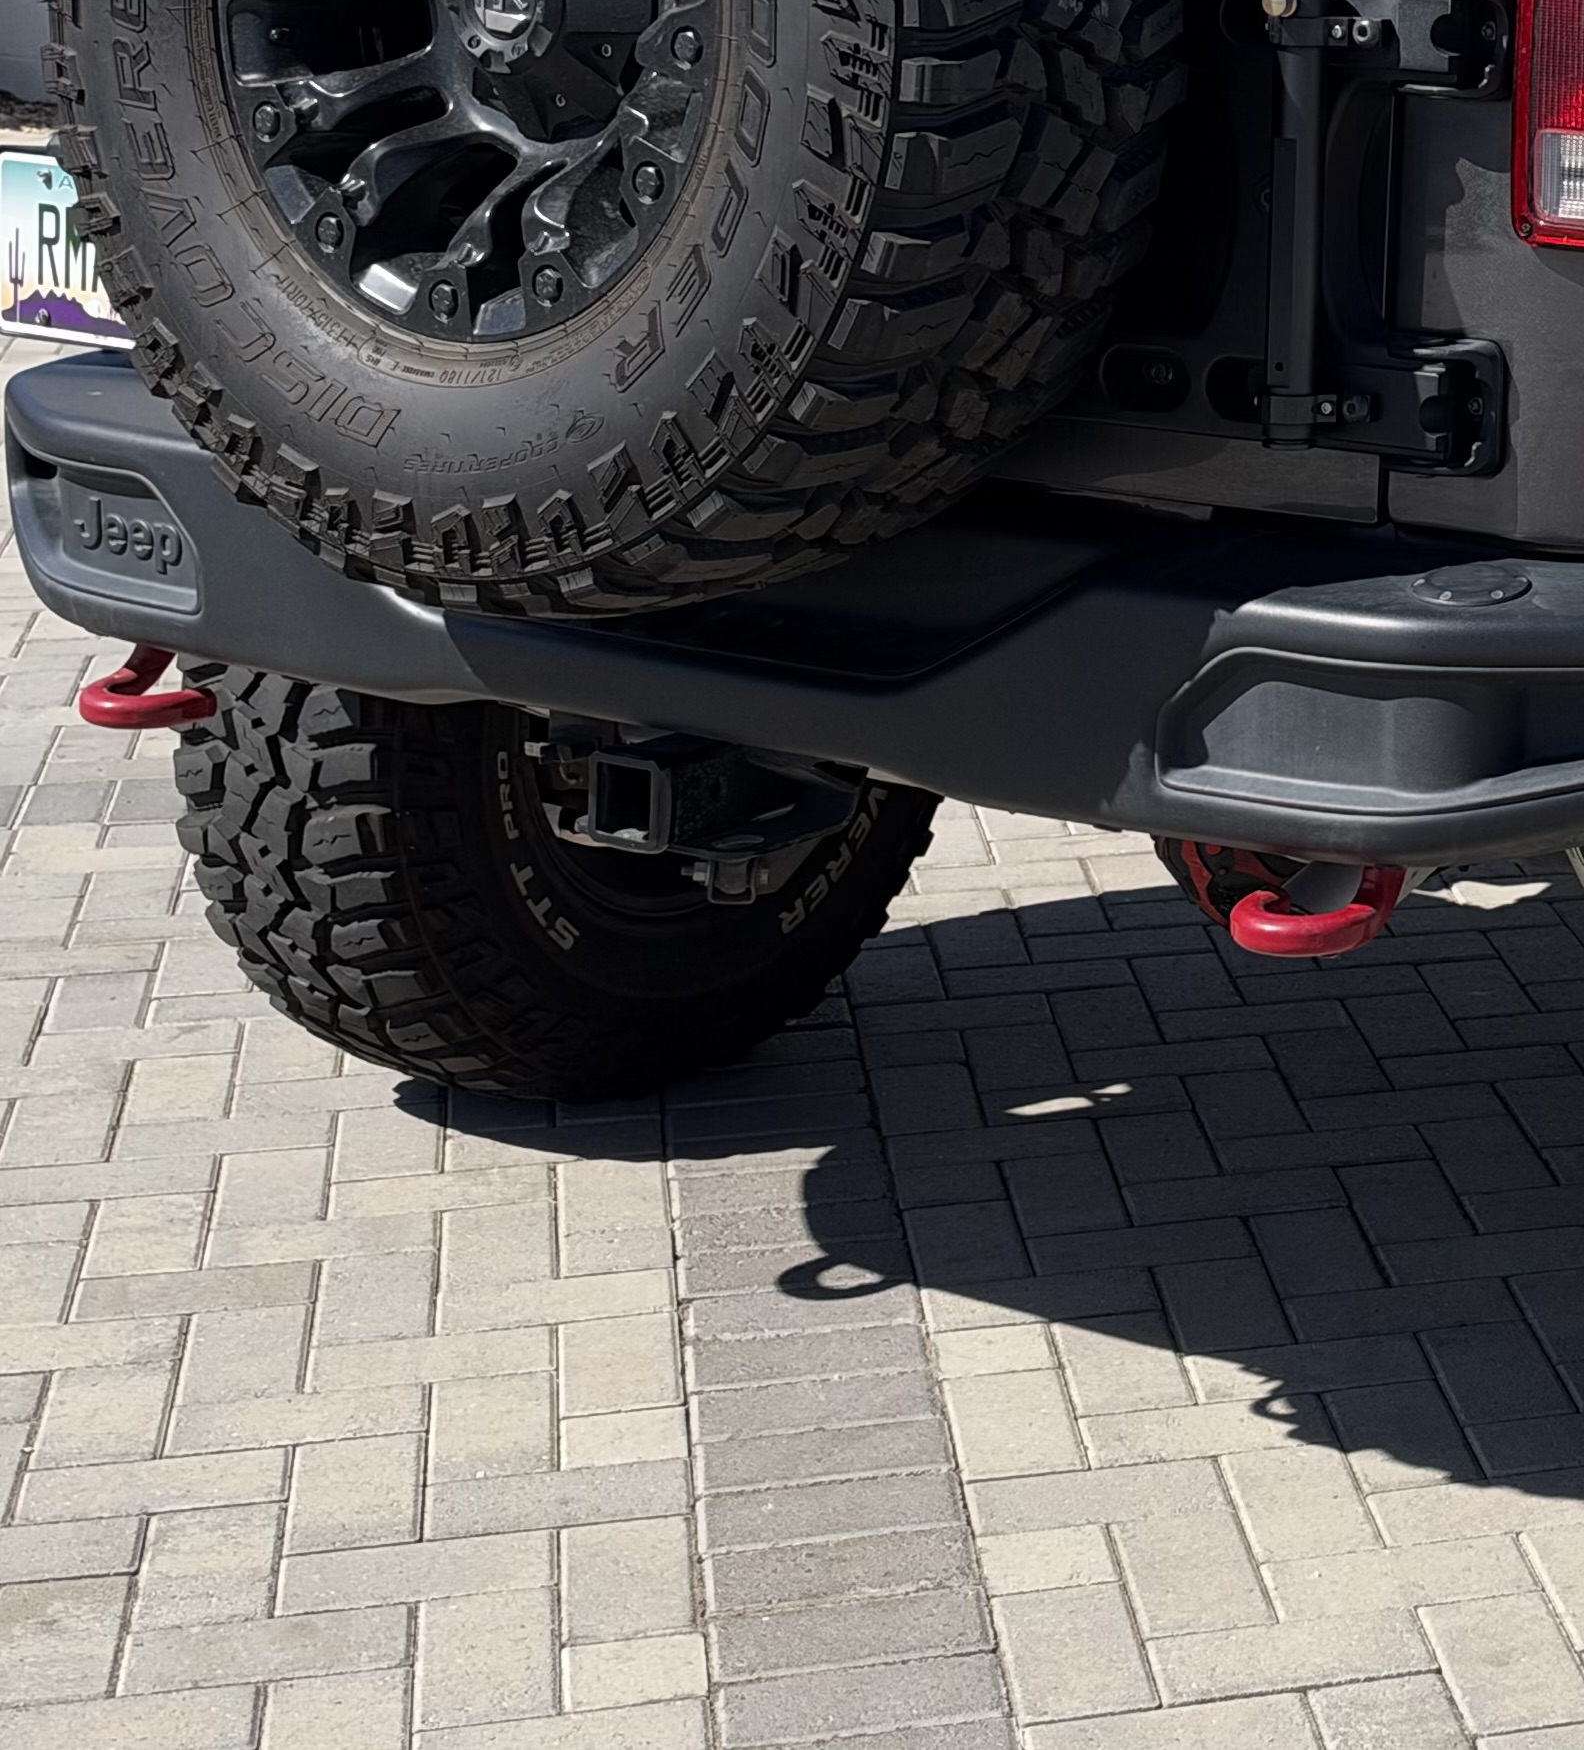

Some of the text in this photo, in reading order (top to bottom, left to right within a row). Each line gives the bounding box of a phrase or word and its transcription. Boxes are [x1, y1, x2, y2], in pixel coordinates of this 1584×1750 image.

[38, 203, 101, 294] RM
[75, 495, 184, 574] Jeep
[496, 750, 582, 951] STT PRO
